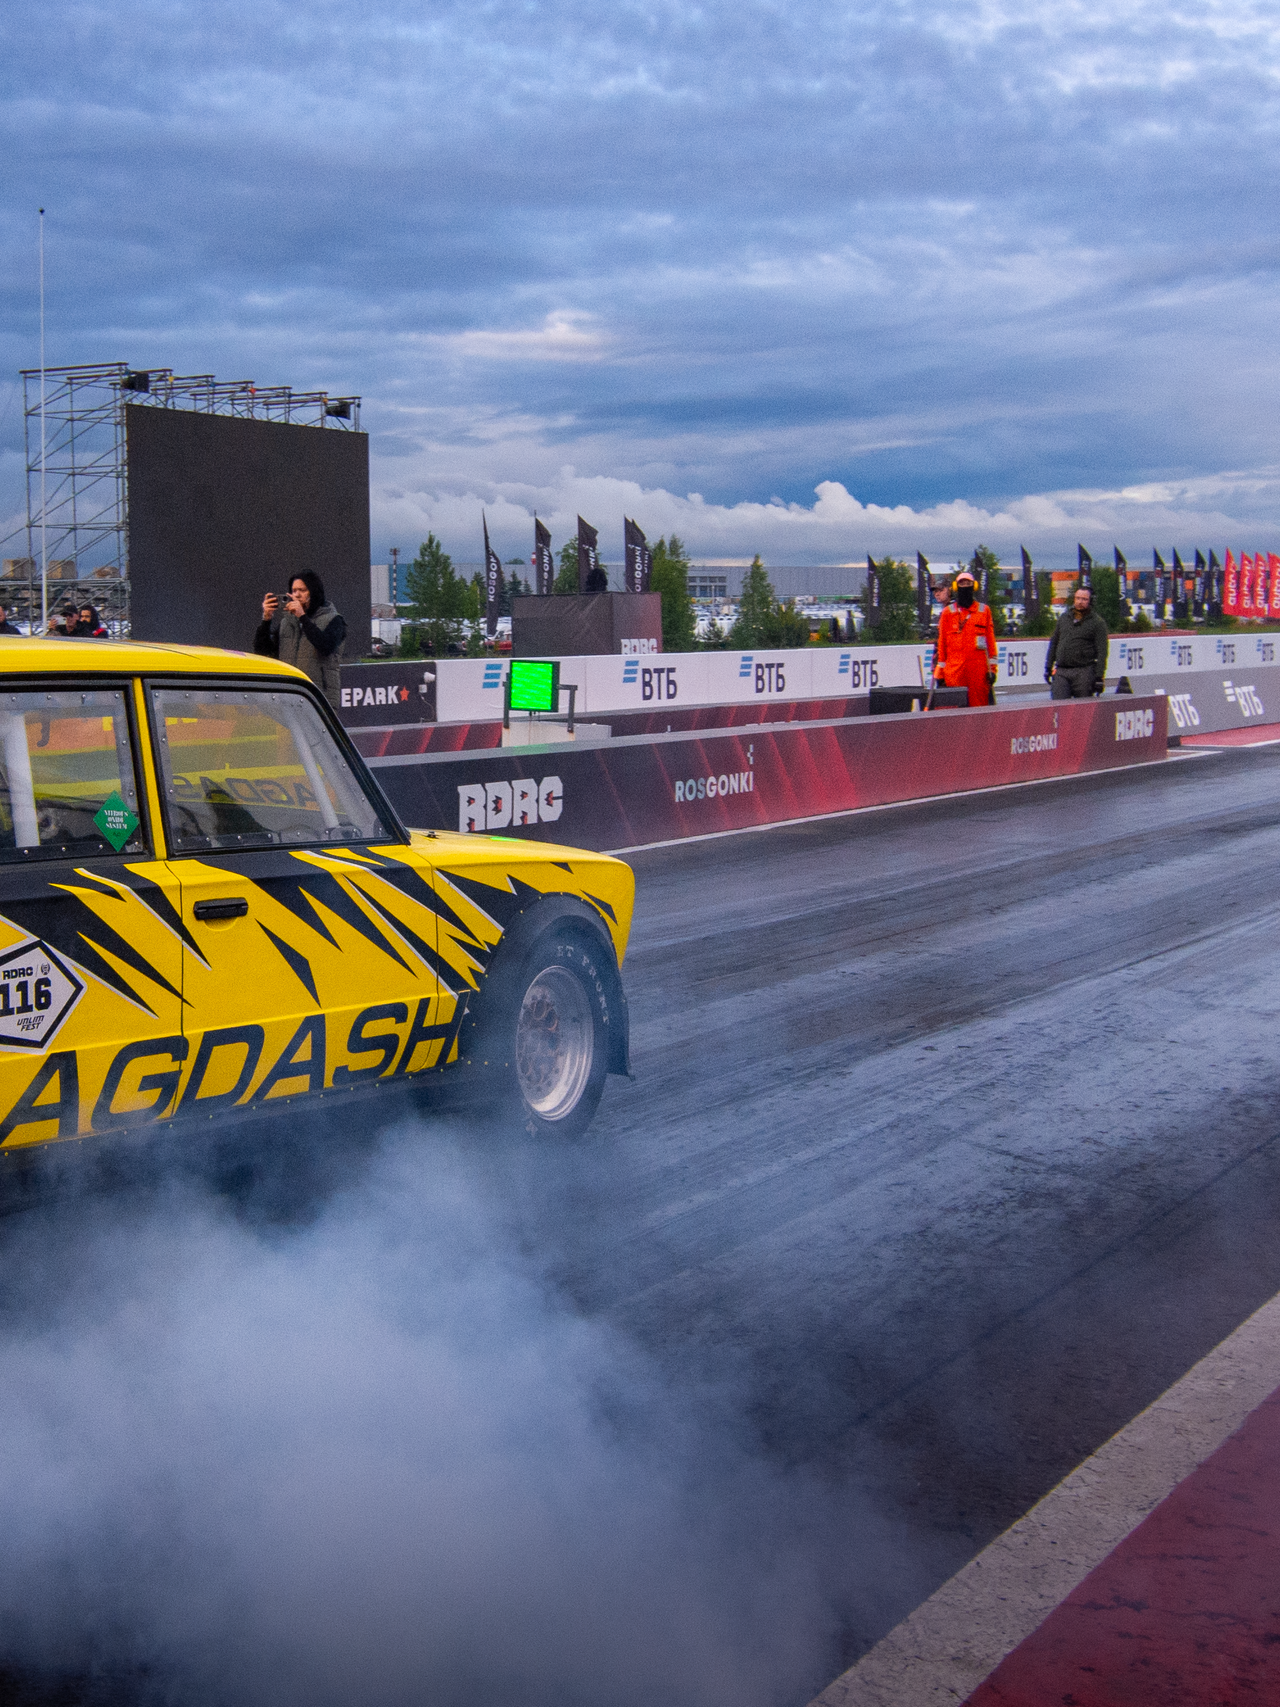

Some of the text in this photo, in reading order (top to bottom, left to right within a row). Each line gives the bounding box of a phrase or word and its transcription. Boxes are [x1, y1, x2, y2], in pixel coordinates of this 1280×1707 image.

[634, 546, 642, 592] OSGONKI
[1008, 652, 1028, 677] ВТБ
[1127, 648, 1143, 670] ВТБ
[1178, 645, 1192, 666] ВТБ
[1222, 644, 1235, 663] ВТБ
[642, 667, 677, 700] ВТБ
[755, 662, 785, 693] ВТБ
[852, 659, 879, 688] ВТБ
[341, 685, 399, 707] EPARK
[1168, 694, 1201, 727] ВТБ
[1235, 685, 1264, 717] ВТБ
[1115, 709, 1155, 741] RDRC
[1011, 733, 1058, 755] ROSGONKI
[675, 771, 754, 803] ROSGONKI
[457, 776, 563, 833] RDRC
[2, 966, 34, 980] RDRC
[20, 1021, 42, 1032] FEST
